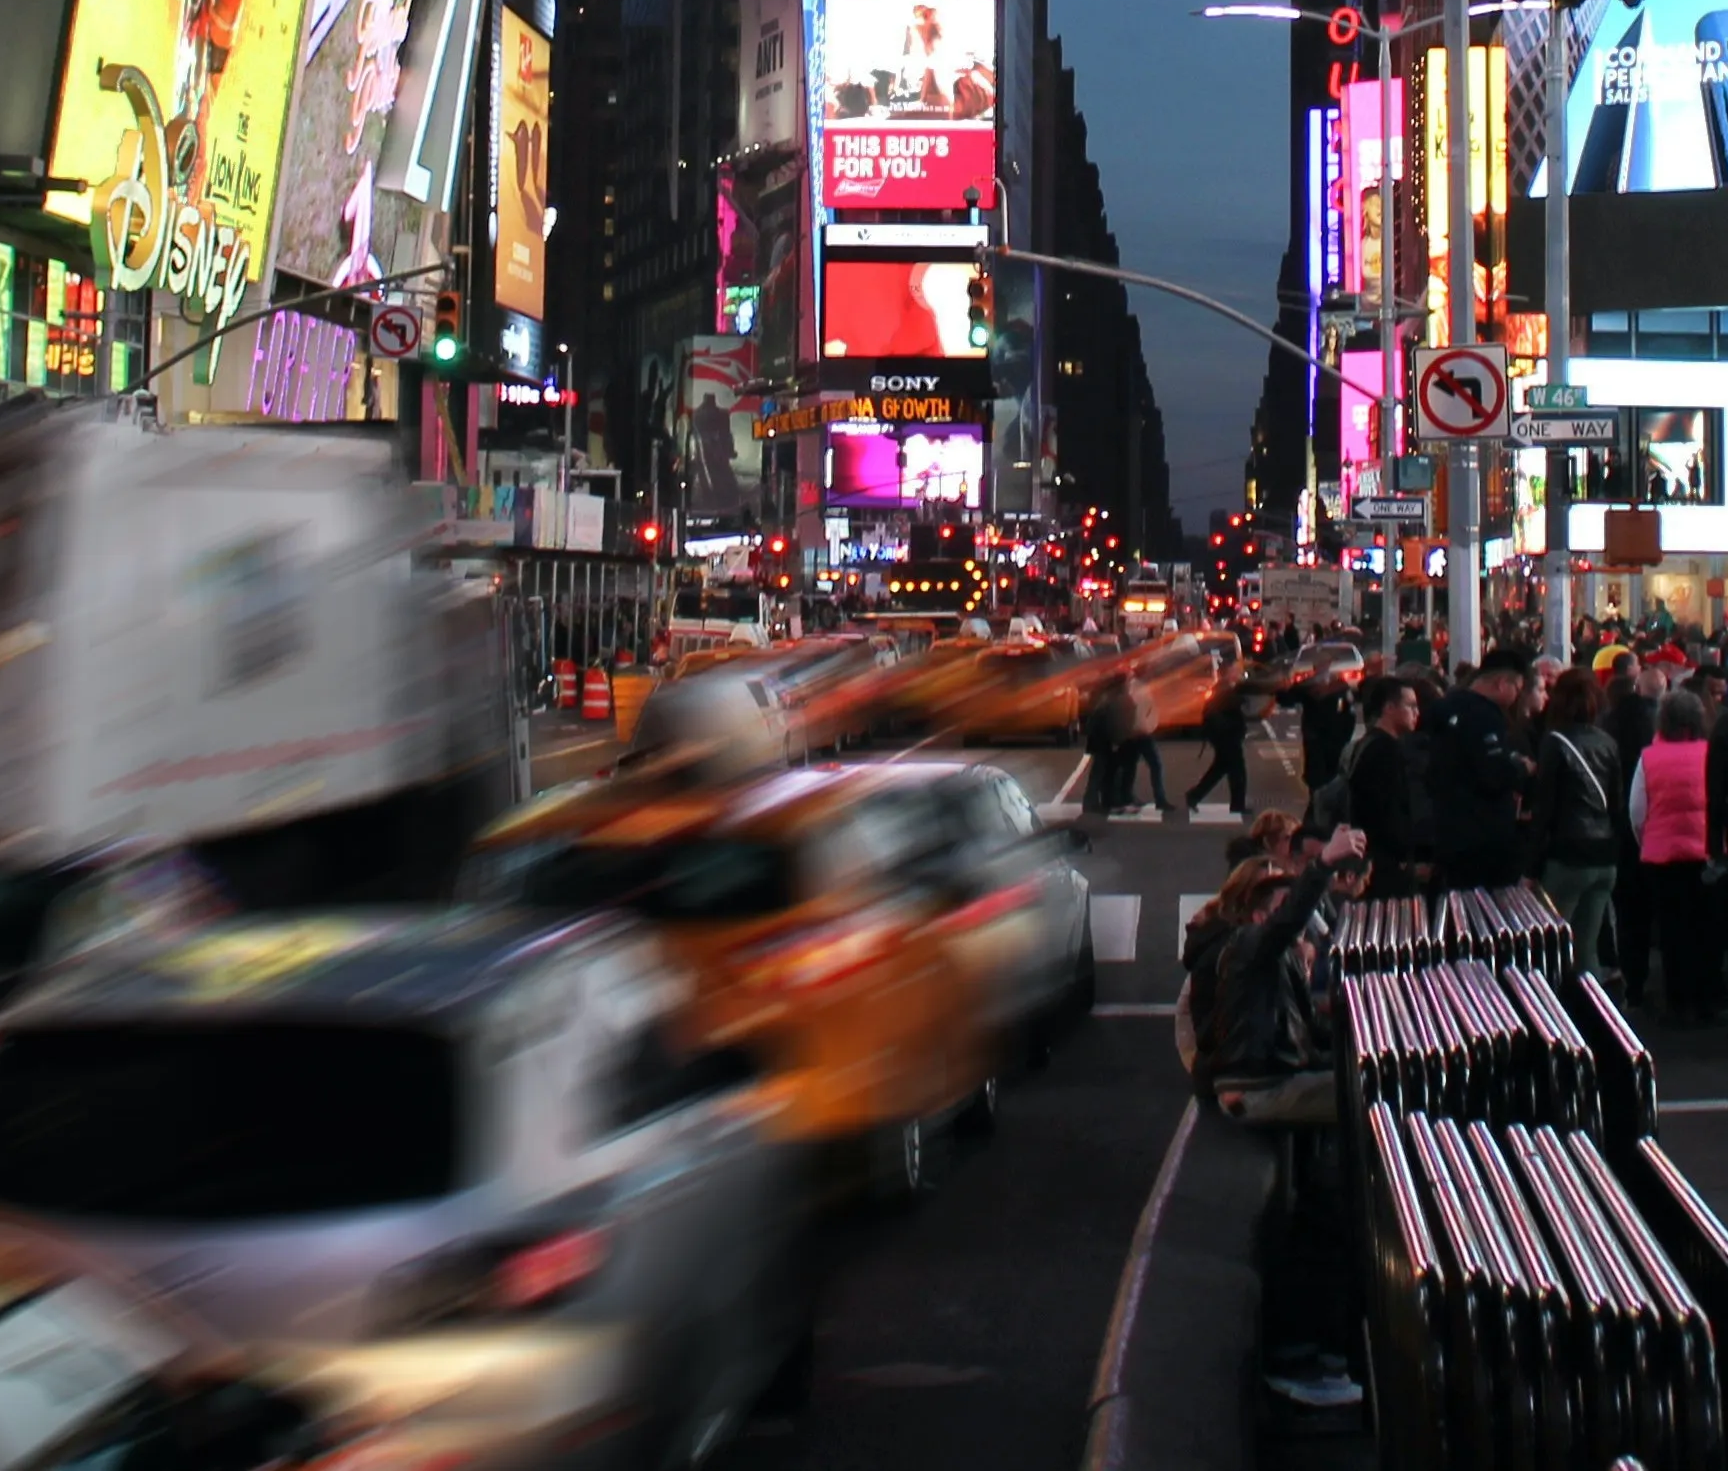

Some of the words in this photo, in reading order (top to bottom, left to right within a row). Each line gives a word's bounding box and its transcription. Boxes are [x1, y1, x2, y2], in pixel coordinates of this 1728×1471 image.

[756, 31, 784, 79] ANTI
[833, 136, 880, 157] THIS
[833, 157, 874, 178] FOR
[879, 158, 927, 178] YOU.
[247, 309, 355, 422] FOREVER
[871, 376, 939, 391] SONY
[1532, 388, 1545, 406] W
[1517, 423, 1552, 437] ONE
[1572, 420, 1608, 437] WAY
[1373, 503, 1395, 514] ONE
[1399, 503, 1415, 514] WAY
